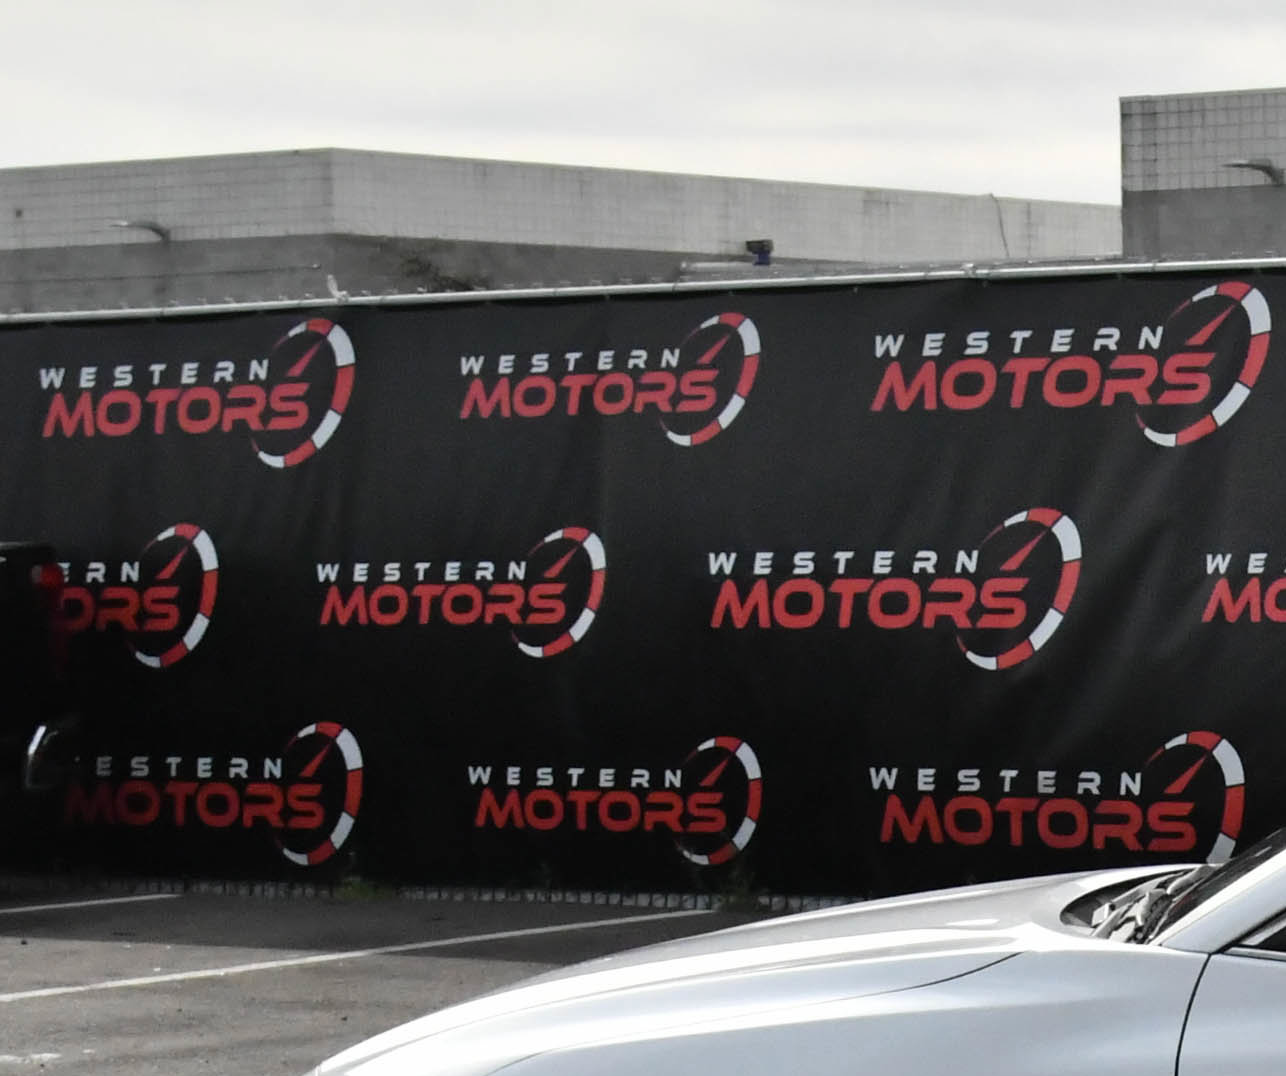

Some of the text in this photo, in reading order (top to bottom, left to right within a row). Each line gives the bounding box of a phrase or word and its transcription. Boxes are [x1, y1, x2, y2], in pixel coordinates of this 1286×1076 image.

[875, 325, 1164, 358] WESTERN
[39, 358, 269, 390] WESTERN
[460, 348, 681, 376] WESTERN
[460, 367, 719, 419] MOTORS
[871, 351, 1215, 412] MOTORS
[42, 381, 310, 438] MOTORS
[316, 561, 527, 583] WESTERN
[708, 549, 979, 575] WESTERN
[319, 581, 567, 627] MOTORS
[710, 576, 1030, 630] MOTORS
[95, 755, 283, 779] ESTERN
[468, 766, 682, 788] WESTERN
[869, 767, 1142, 796] WESTERN
[474, 787, 728, 833] MOTORS
[879, 793, 1199, 852] MOTORS
